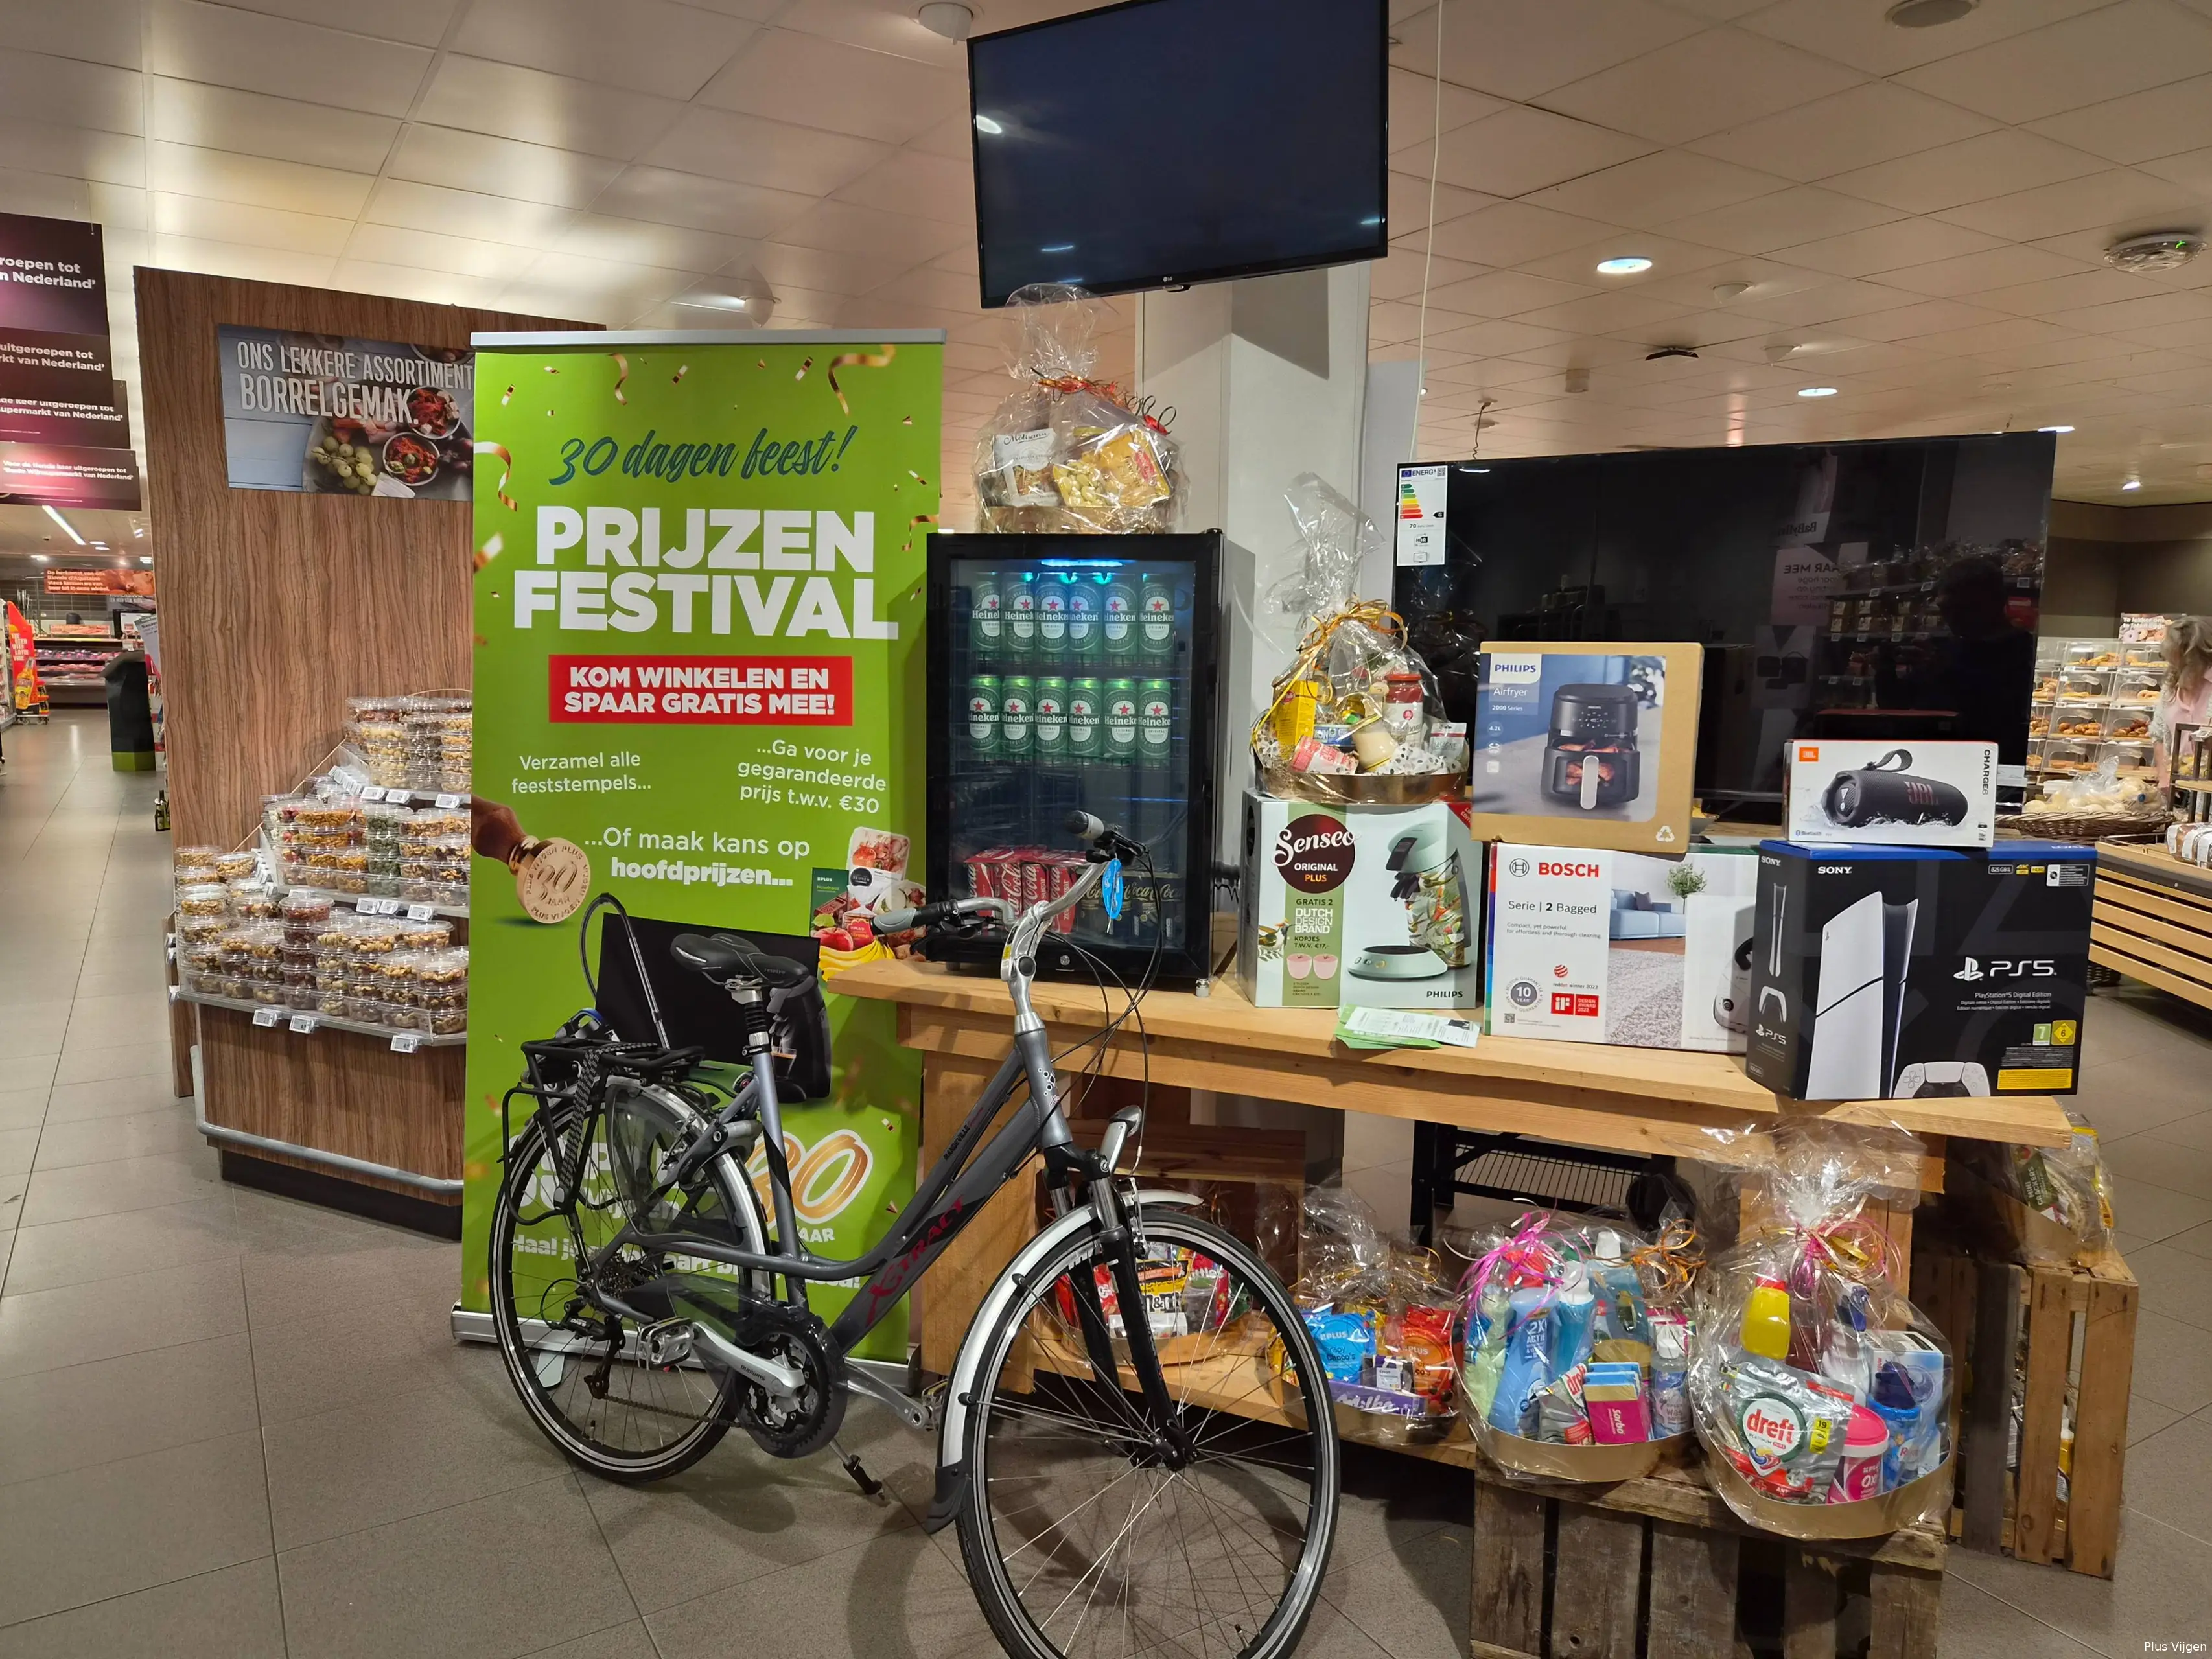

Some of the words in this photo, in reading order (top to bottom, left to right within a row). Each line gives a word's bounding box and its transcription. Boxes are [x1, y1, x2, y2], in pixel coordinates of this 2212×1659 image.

[58, 262, 81, 274] tot
[13, 272, 96, 290] Nederland'
[0, 343, 73, 358] uitgeroepen
[76, 350, 94, 360] tot
[17, 356, 39, 366] van
[41, 358, 105, 372] Nederland'
[237, 341, 274, 371] ONS
[280, 345, 356, 380] LEKKERE
[363, 354, 474, 390] ASSORTIMENT
[240, 373, 419, 425] BORRELGEMAK.
[73, 412, 123, 422] Nederland'
[549, 435, 618, 485] 30
[623, 429, 739, 483] dagen
[741, 425, 858, 480] feest!
[73, 465, 115, 474] uitgeroepen
[537, 506, 874, 572] PRIJZEN
[514, 570, 899, 640] FESTIVAL
[972, 610, 999, 619] Heine
[1495, 664, 1536, 673] PHILIPS
[570, 667, 630, 688] KOM
[637, 667, 785, 689] WINKELEN
[791, 669, 829, 689] EN
[1493, 687, 1528, 697] Airfryer
[564, 693, 656, 713] SPAAR
[662, 693, 762, 714] GRATIS
[769, 694, 835, 715] MEE!
[1138, 717, 1171, 726] Heineke
[520, 753, 603, 771] Verzamel
[609, 751, 641, 767] alle
[804, 747, 848, 762] voor
[853, 750, 872, 767] je
[737, 760, 887, 792] gegarandeerde
[511, 774, 651, 795] feeststempels...
[740, 785, 782, 804] prijs
[788, 791, 832, 809] t.w.v.
[839, 795, 880, 815] €30
[585, 826, 631, 848] ...Of
[638, 831, 704, 851] maak
[713, 836, 770, 855] kans
[778, 841, 810, 859] op
[1271, 828, 1360, 867] Senseo
[1294, 863, 1338, 872] ORIGINAL
[1761, 855, 1782, 867] SONY
[611, 857, 793, 887] hoofdprijzen...
[1539, 862, 1600, 878] BOSCH
[1817, 866, 1852, 874] SONY
[1304, 874, 1327, 883] PLUS
[1295, 908, 1333, 918] DUTCH
[1508, 900, 1535, 911] Serie
[1546, 903, 1552, 911] 2
[1557, 903, 1597, 914] Bagged
[1295, 916, 1333, 925] DESIGN
[1294, 924, 1331, 934] BRAND
[1990, 960, 2055, 977] PS5
[1516, 986, 1531, 997] 10
[1765, 1028, 1787, 1045] PS5
[2038, 1026, 2046, 1039] 7
[2024, 1179, 2036, 1199] MINI
[2031, 1166, 2044, 1205] CRACKERS
[797, 1226, 835, 1242] AAR
[1327, 1330, 1347, 1340] PLUS
[1408, 1346, 1428, 1356] PLUS
[1612, 1408, 1626, 1435] Sorbo
[1747, 1408, 1795, 1444] dreft
[1818, 1419, 1827, 1429] 19
